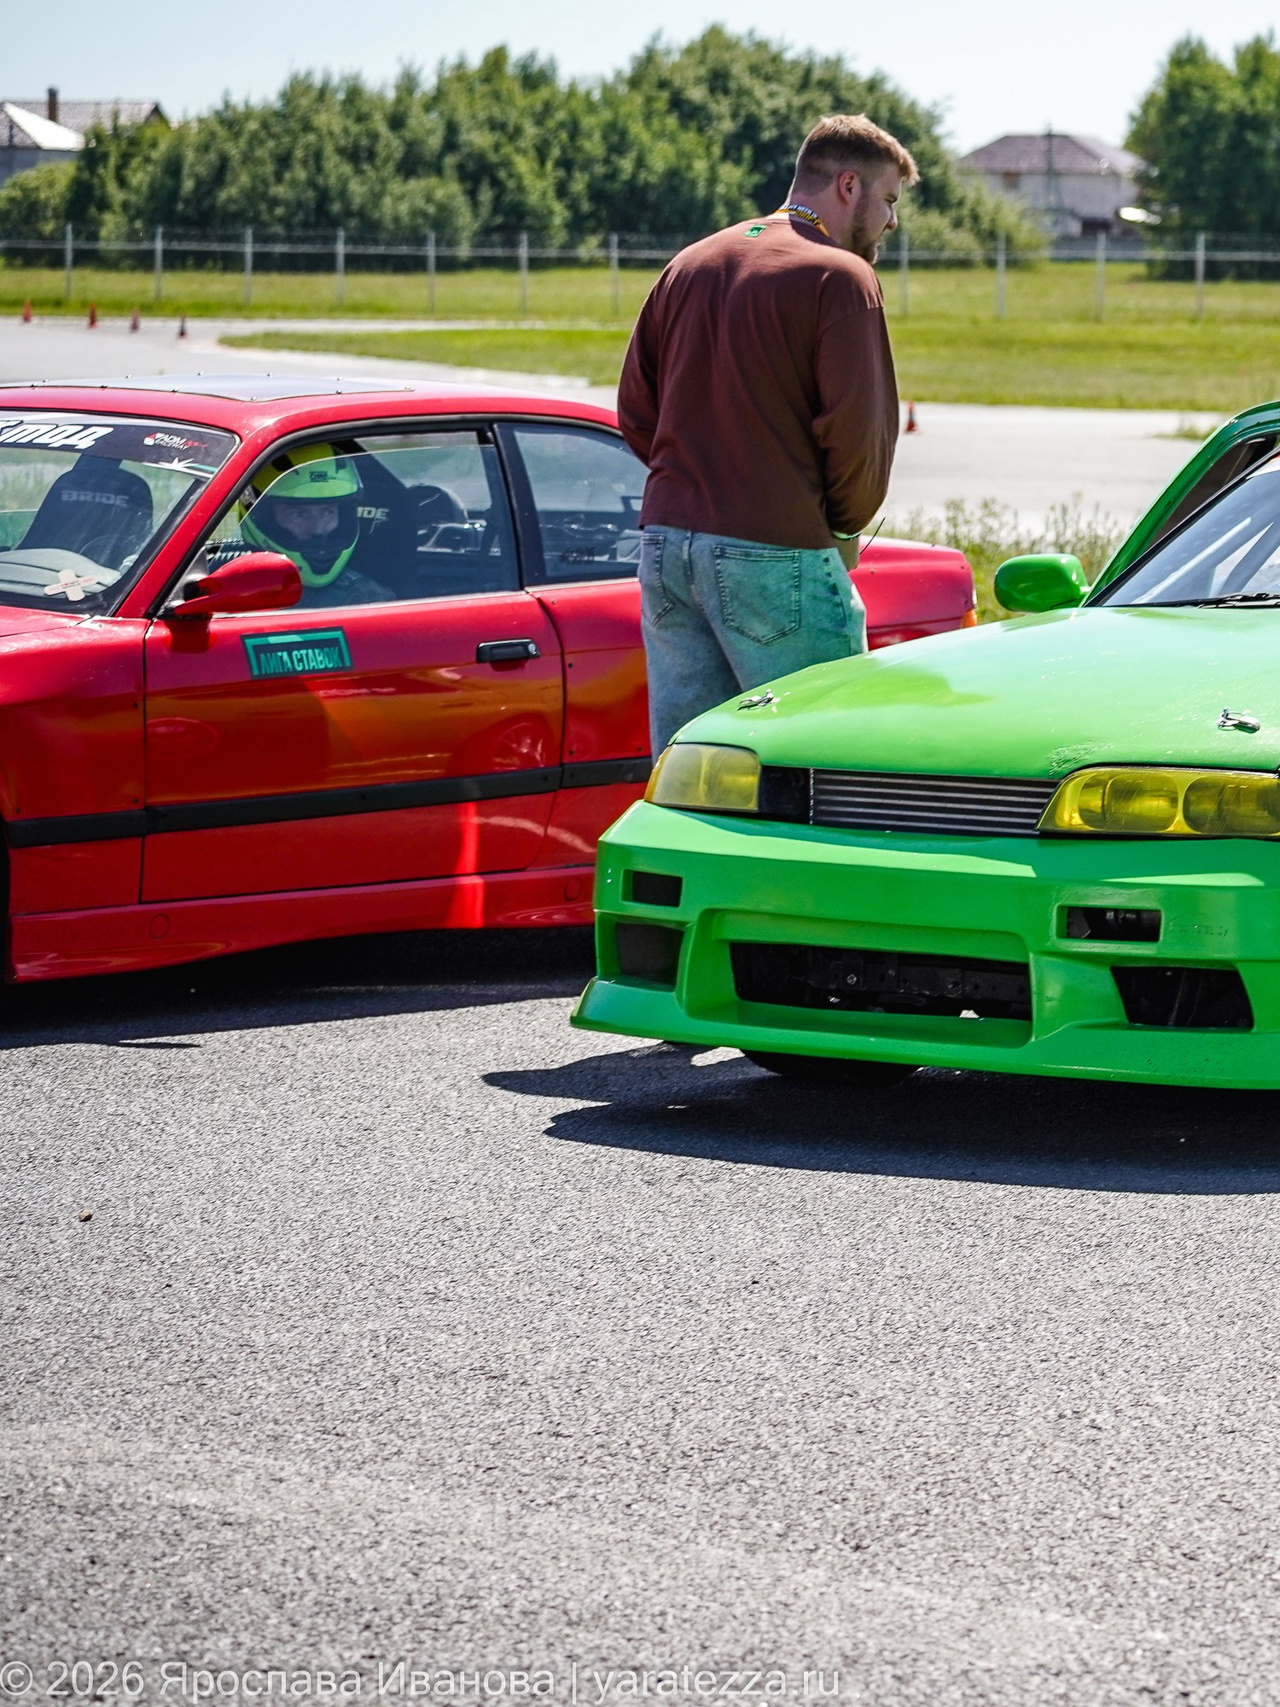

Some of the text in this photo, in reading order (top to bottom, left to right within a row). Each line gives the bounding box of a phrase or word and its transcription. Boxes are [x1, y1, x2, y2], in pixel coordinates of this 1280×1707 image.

[60, 489, 131, 507] BRIDE
[357, 506, 389, 520] IDE
[292, 646, 342, 672] СТАВОК
